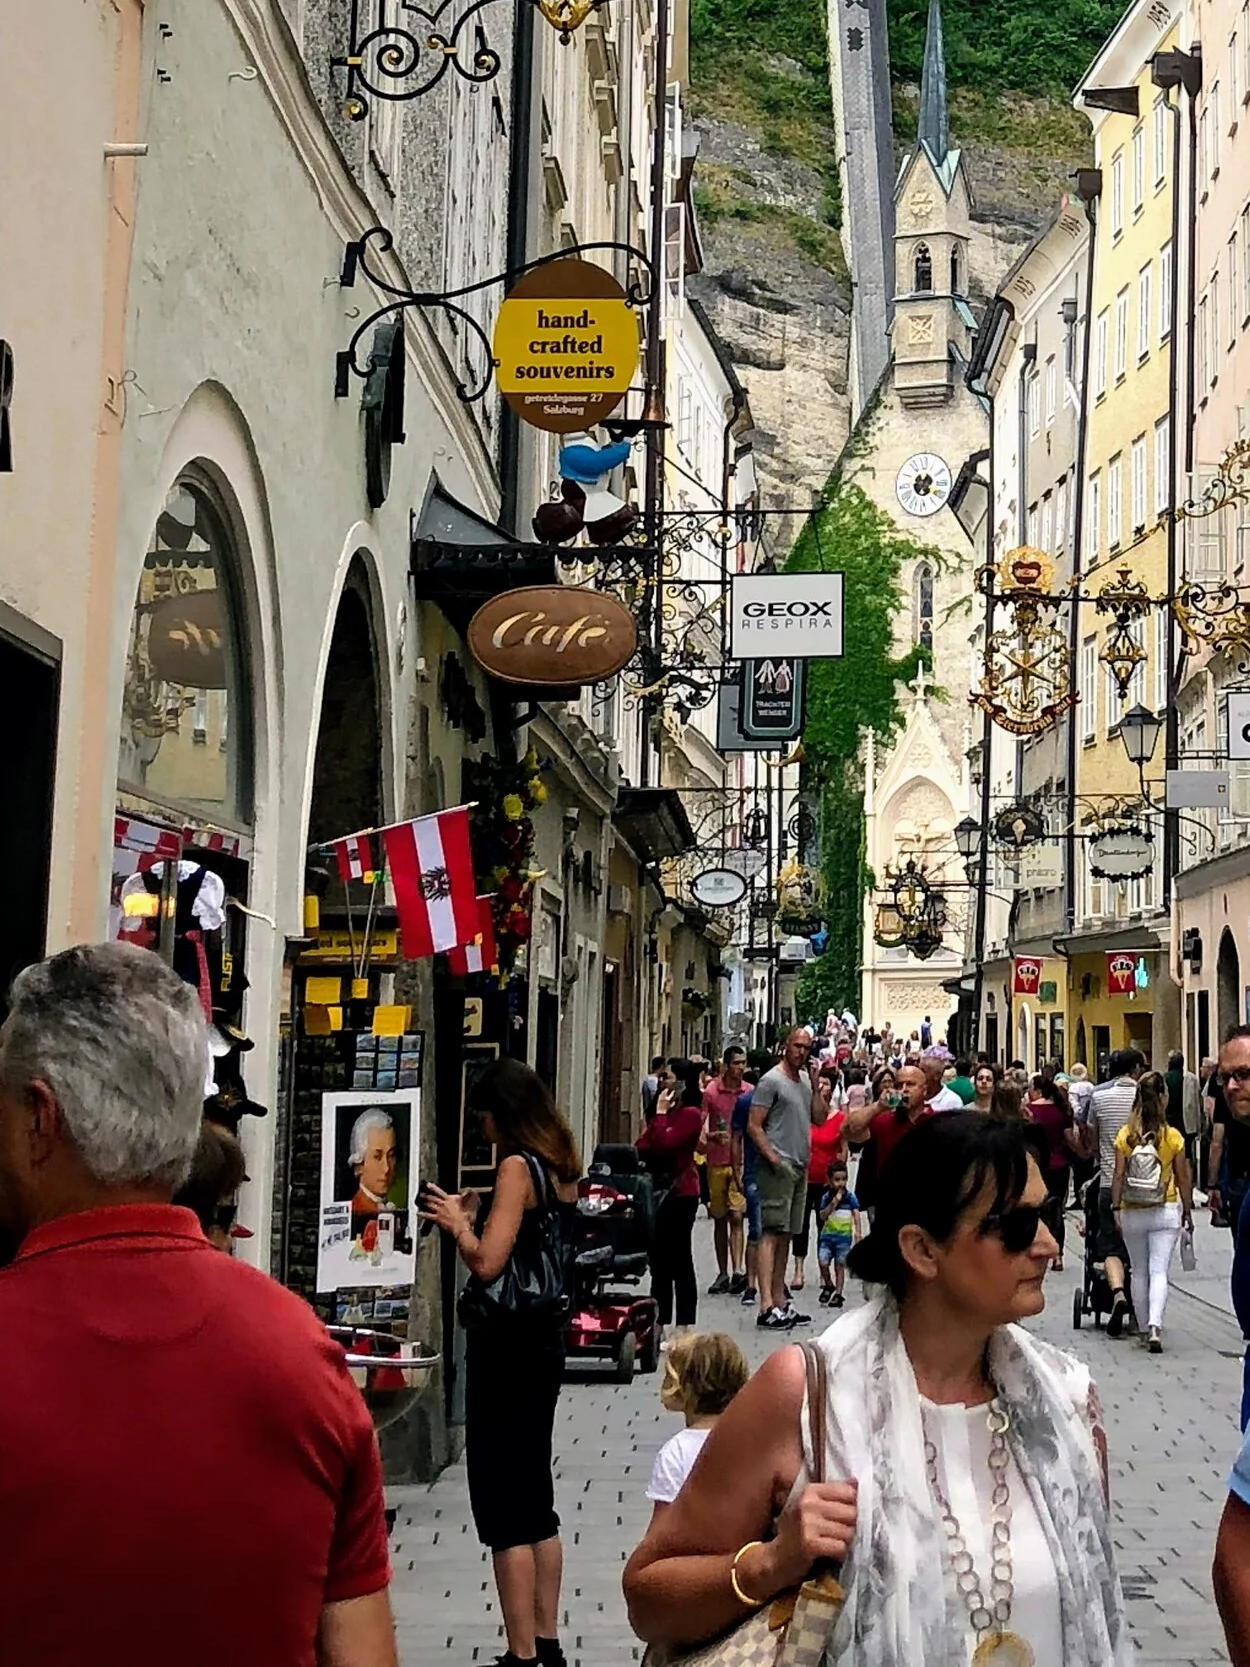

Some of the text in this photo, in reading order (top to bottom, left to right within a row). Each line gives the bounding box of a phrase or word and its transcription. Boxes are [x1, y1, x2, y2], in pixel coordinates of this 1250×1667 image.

[537, 309, 596, 329] hand-
[528, 334, 603, 354] crafted
[515, 360, 615, 379] souvenirs
[590, 393, 603, 402] 27
[543, 404, 585, 415] Salzburg
[742, 601, 833, 618] GEOX
[742, 618, 833, 630] RESPIRA
